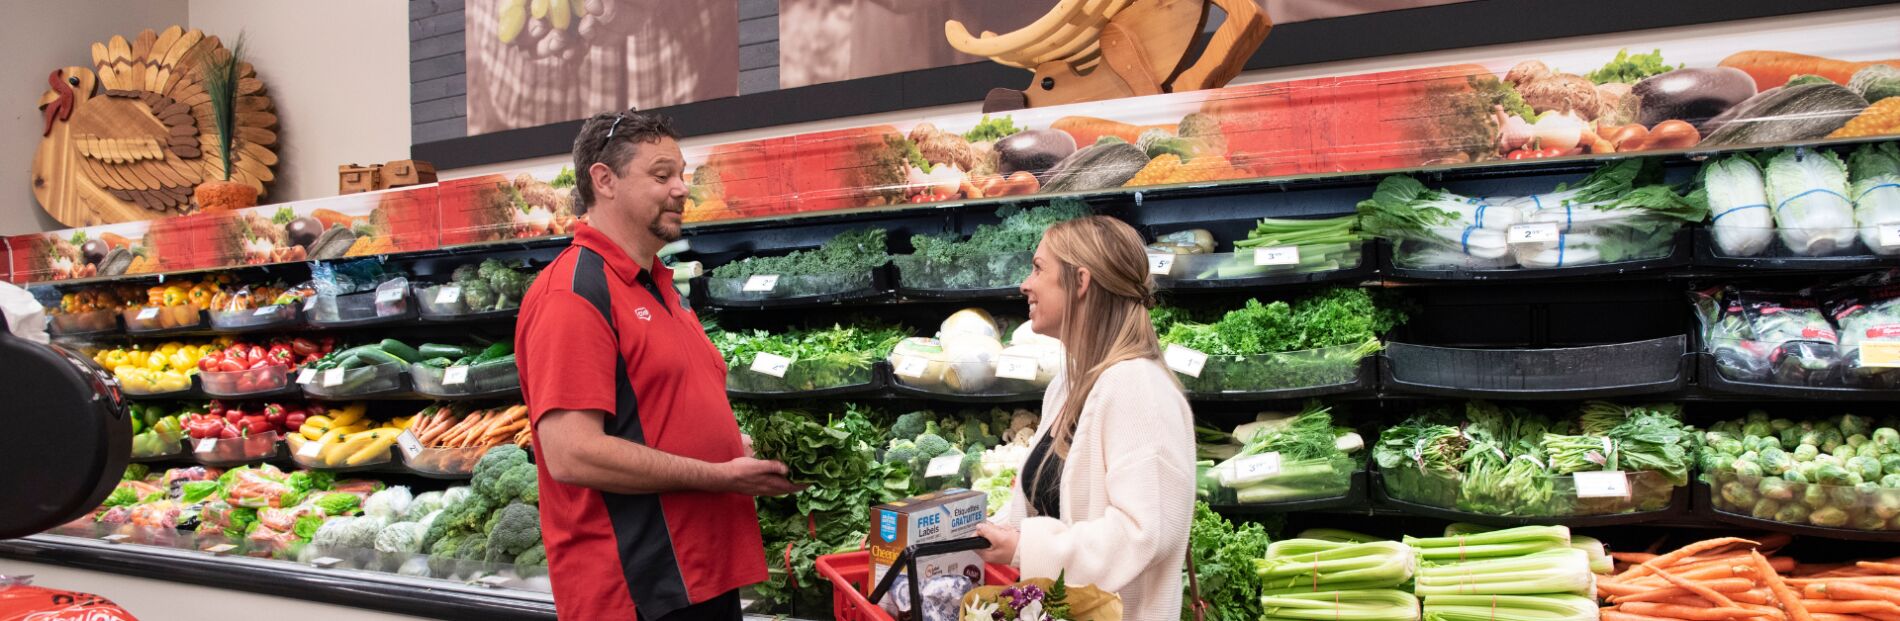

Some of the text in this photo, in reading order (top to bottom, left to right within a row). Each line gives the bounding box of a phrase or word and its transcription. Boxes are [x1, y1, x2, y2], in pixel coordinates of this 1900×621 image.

[917, 512, 940, 528] FREE
[951, 510, 982, 528] GRATUITES
[918, 525, 940, 538] Labels
